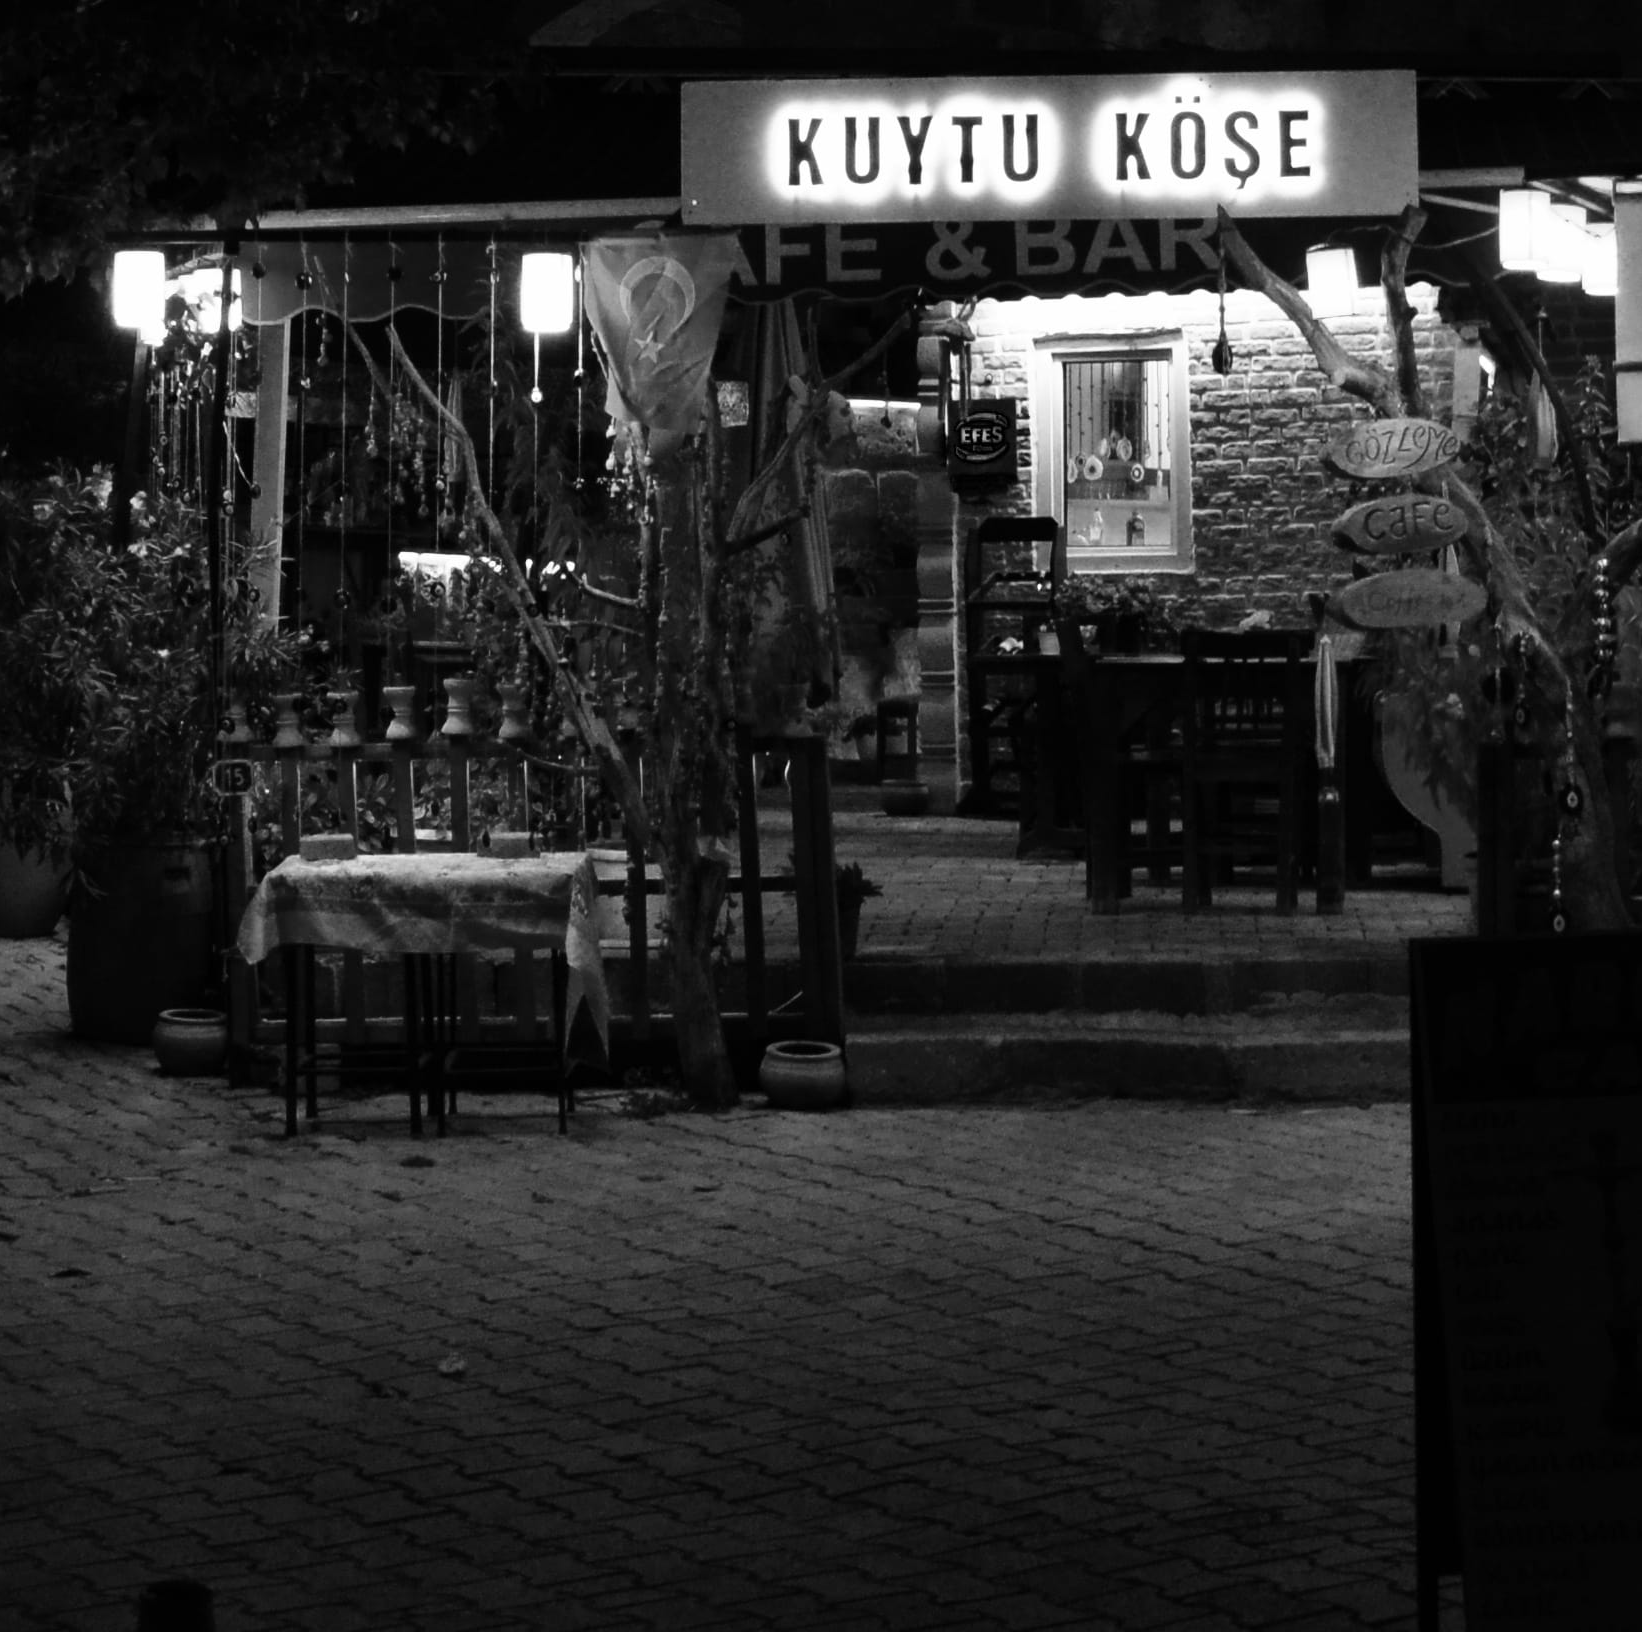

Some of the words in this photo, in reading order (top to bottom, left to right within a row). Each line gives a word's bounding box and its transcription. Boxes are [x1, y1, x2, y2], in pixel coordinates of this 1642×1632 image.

[787, 113, 1039, 185] KUYTU
[1114, 96, 1312, 189] KÖŞE
[1014, 218, 1222, 276] BAR
[960, 426, 1003, 443] EFES
